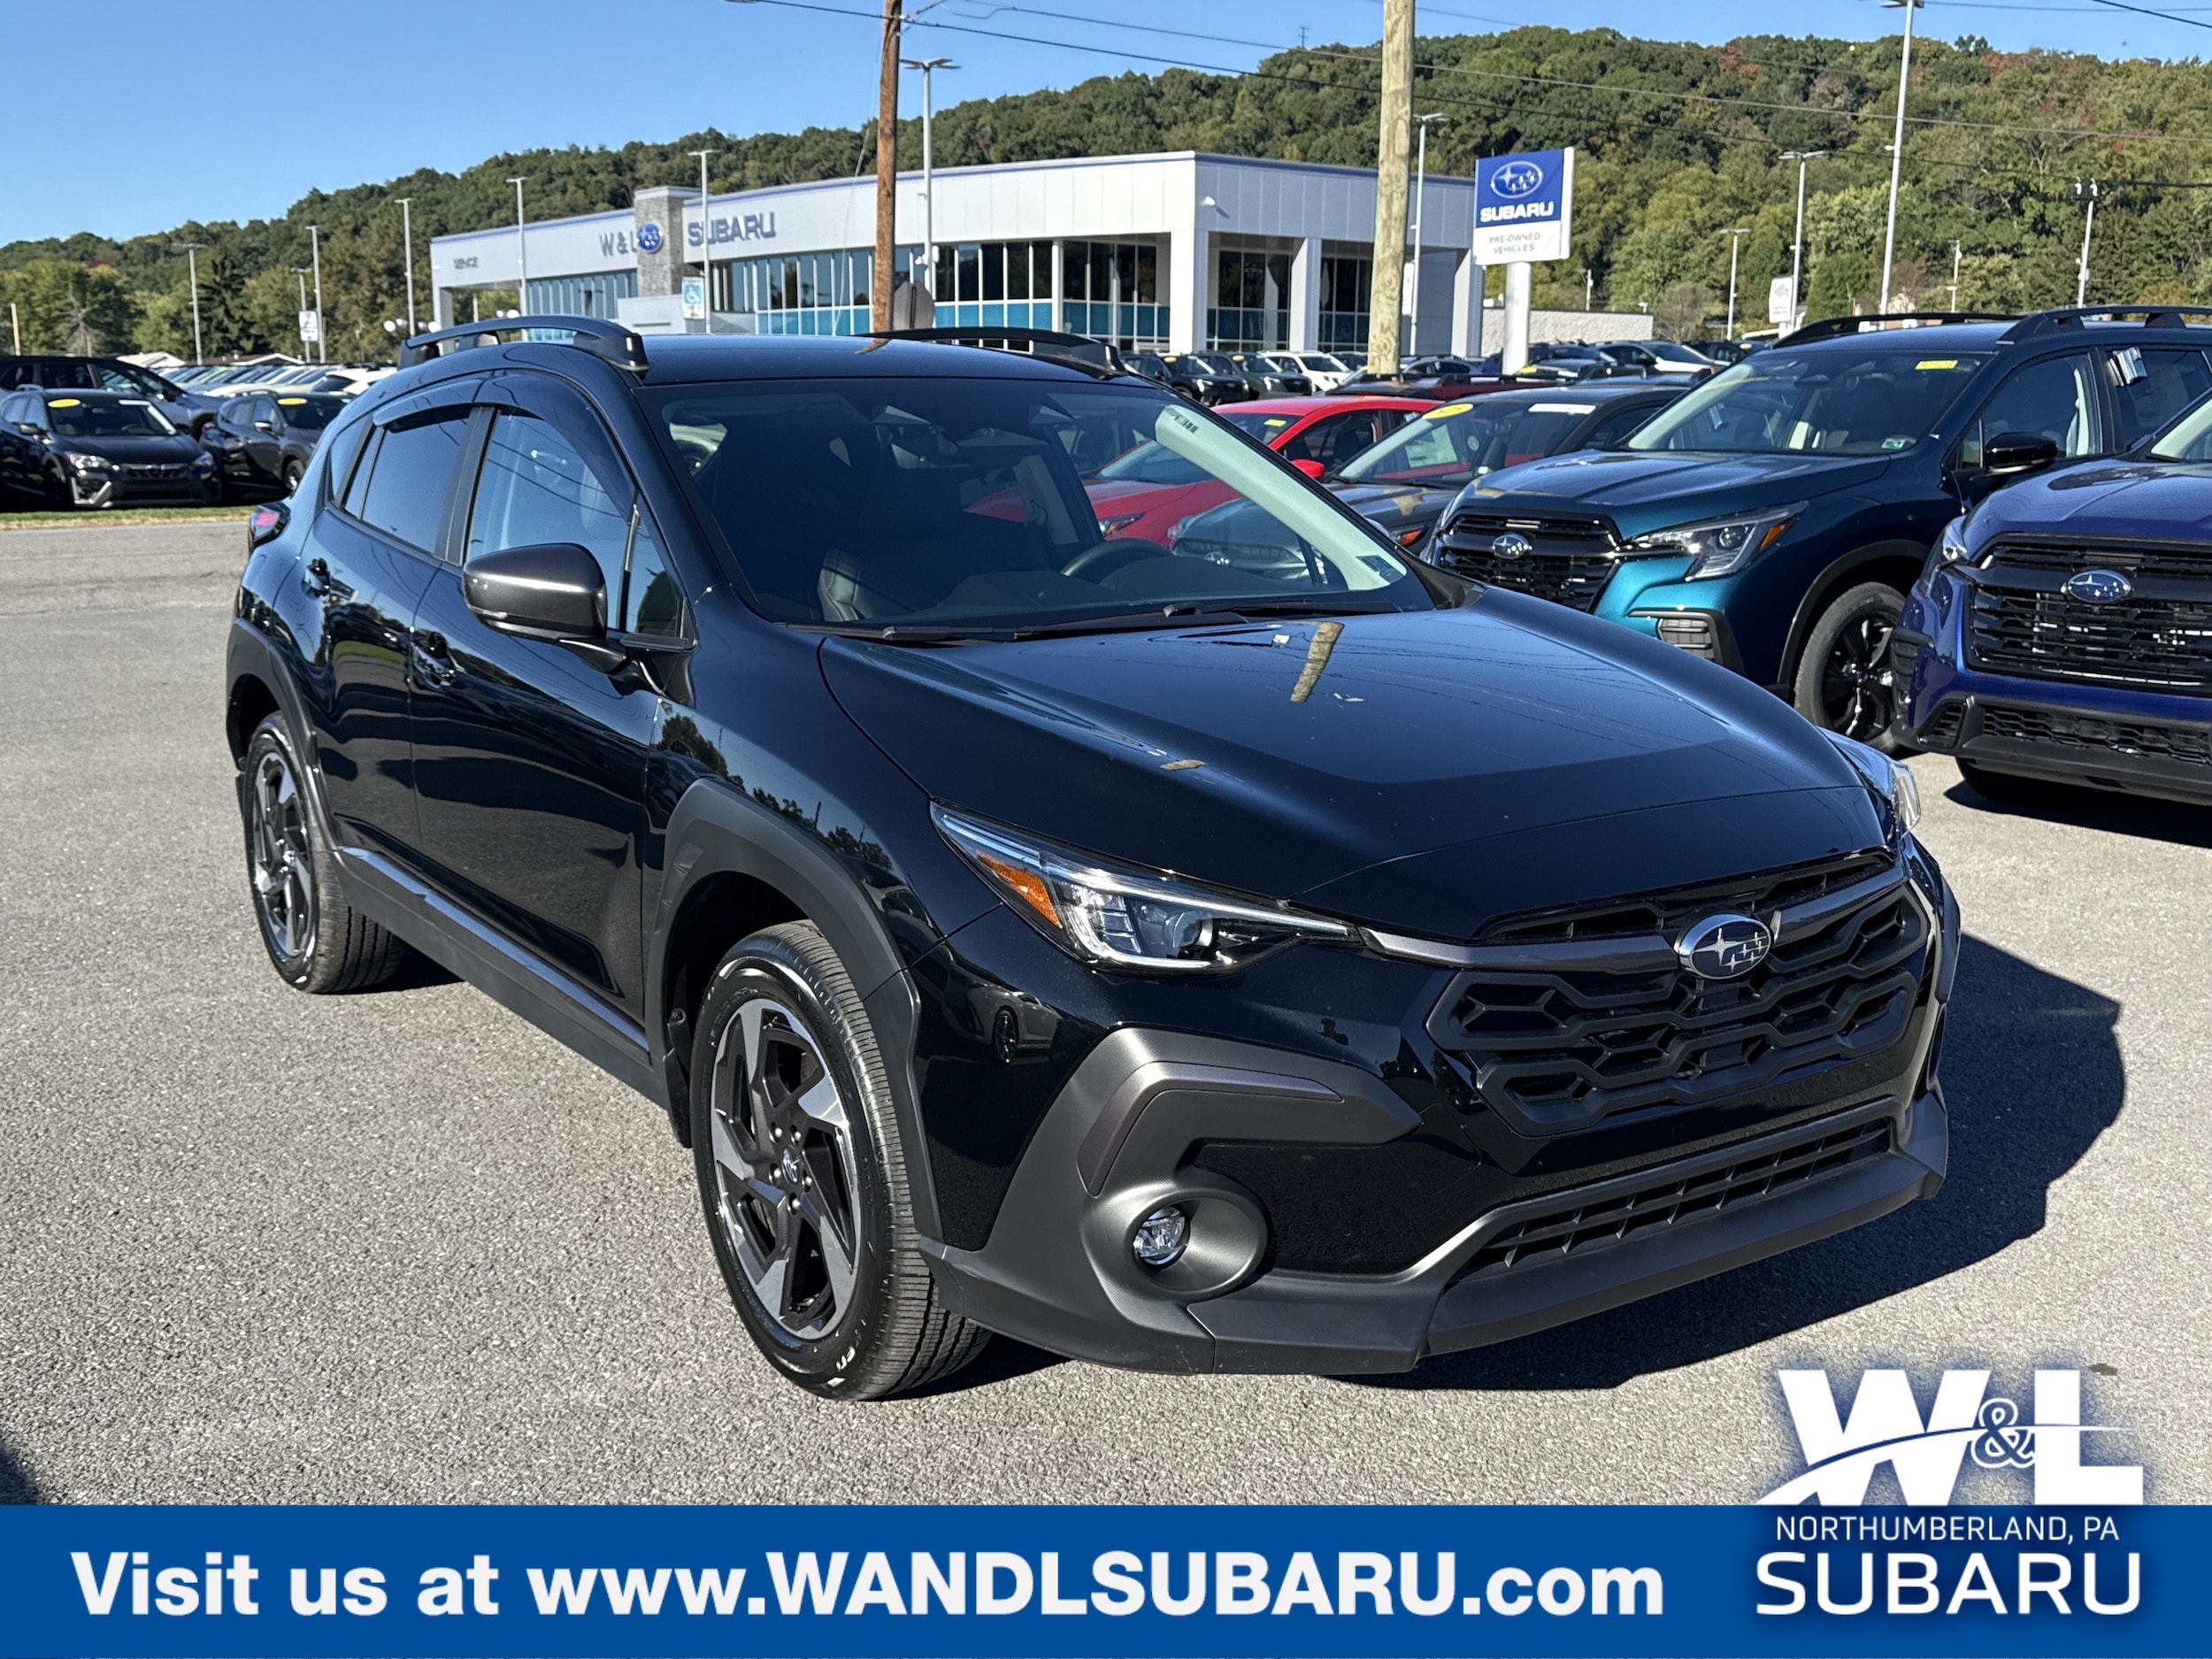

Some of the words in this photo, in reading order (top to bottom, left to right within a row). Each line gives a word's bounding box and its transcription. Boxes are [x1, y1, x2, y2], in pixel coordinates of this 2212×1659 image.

[1479, 201, 1555, 222] SUBARU
[687, 212, 776, 247] SUBARU
[1488, 232, 1541, 244] PRE-OWNED
[1493, 243, 1535, 255] VEHICLES
